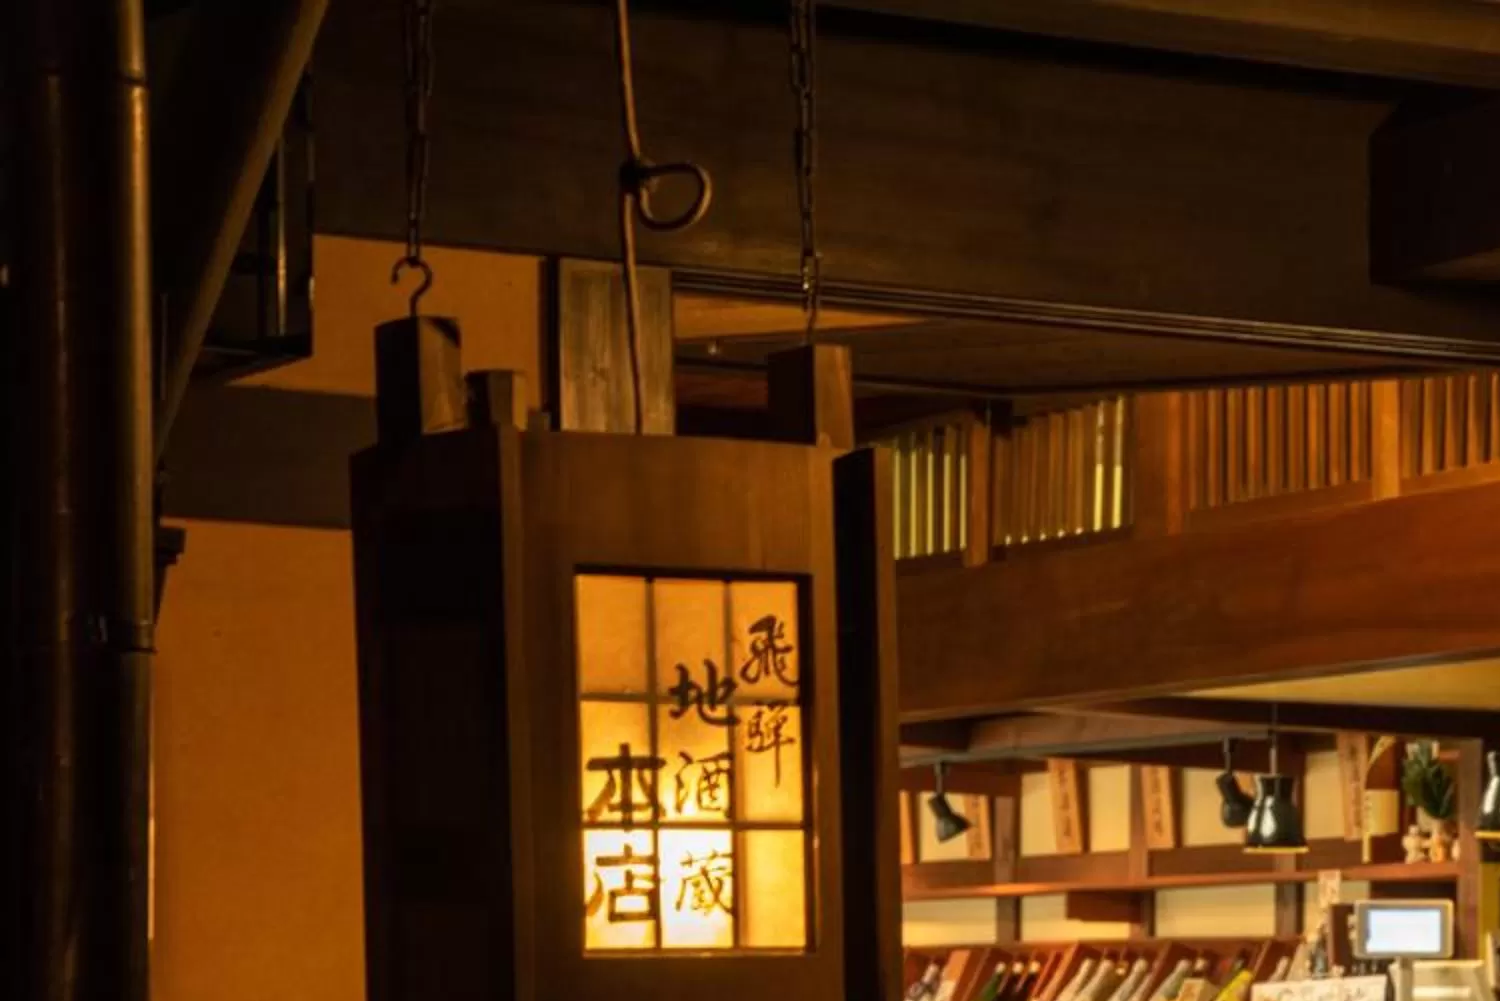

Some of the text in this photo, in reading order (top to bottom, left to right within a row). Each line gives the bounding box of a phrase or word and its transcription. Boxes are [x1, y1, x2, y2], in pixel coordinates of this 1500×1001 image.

[668, 658, 740, 917] 地酒蔵
[740, 615, 801, 788] 飛騨
[584, 743, 667, 922] 本店
